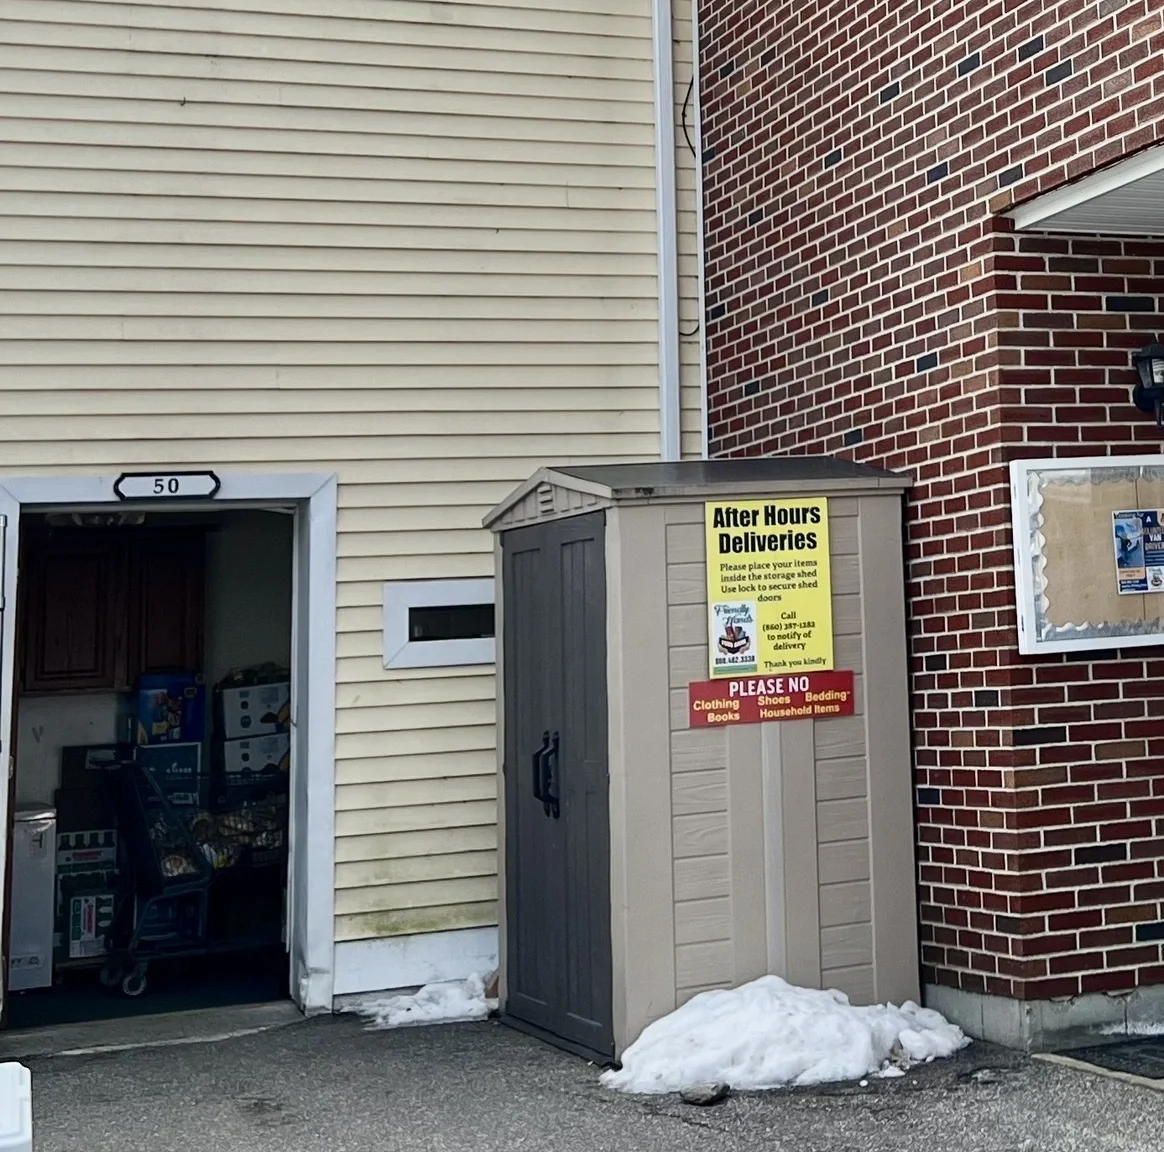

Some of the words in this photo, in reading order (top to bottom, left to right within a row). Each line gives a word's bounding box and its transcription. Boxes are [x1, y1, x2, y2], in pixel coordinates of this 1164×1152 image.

[153, 478, 179, 494] 50
[713, 506, 759, 528] After
[764, 505, 821, 526] Hours
[719, 530, 817, 554] Deliveries
[720, 562, 747, 571] Please
[748, 561, 771, 572] place
[773, 561, 792, 570] your
[794, 559, 818, 567] items
[721, 573, 746, 582] inside
[748, 572, 762, 581] the
[764, 571, 795, 581] storage
[797, 569, 817, 578] shed
[721, 585, 737, 593] Use
[738, 583, 756, 592] lock
[768, 583, 796, 591] secure
[798, 580, 818, 588] shed
[757, 594, 782, 602] doors
[781, 611, 797, 620] Call
[767, 633, 776, 641] to
[777, 631, 801, 641] notify
[803, 630, 812, 638] of
[773, 641, 806, 651] delivery
[764, 660, 788, 668] Thank
[788, 660, 802, 668] you
[803, 657, 827, 666] kindly
[729, 678, 783, 697] PLEASE
[788, 676, 809, 693] NO
[693, 699, 740, 711] Clothing
[757, 695, 791, 706] Shoes
[805, 690, 847, 702] Bedding
[707, 711, 741, 723] Books
[760, 707, 813, 719] Household
[814, 703, 840, 714] Items
